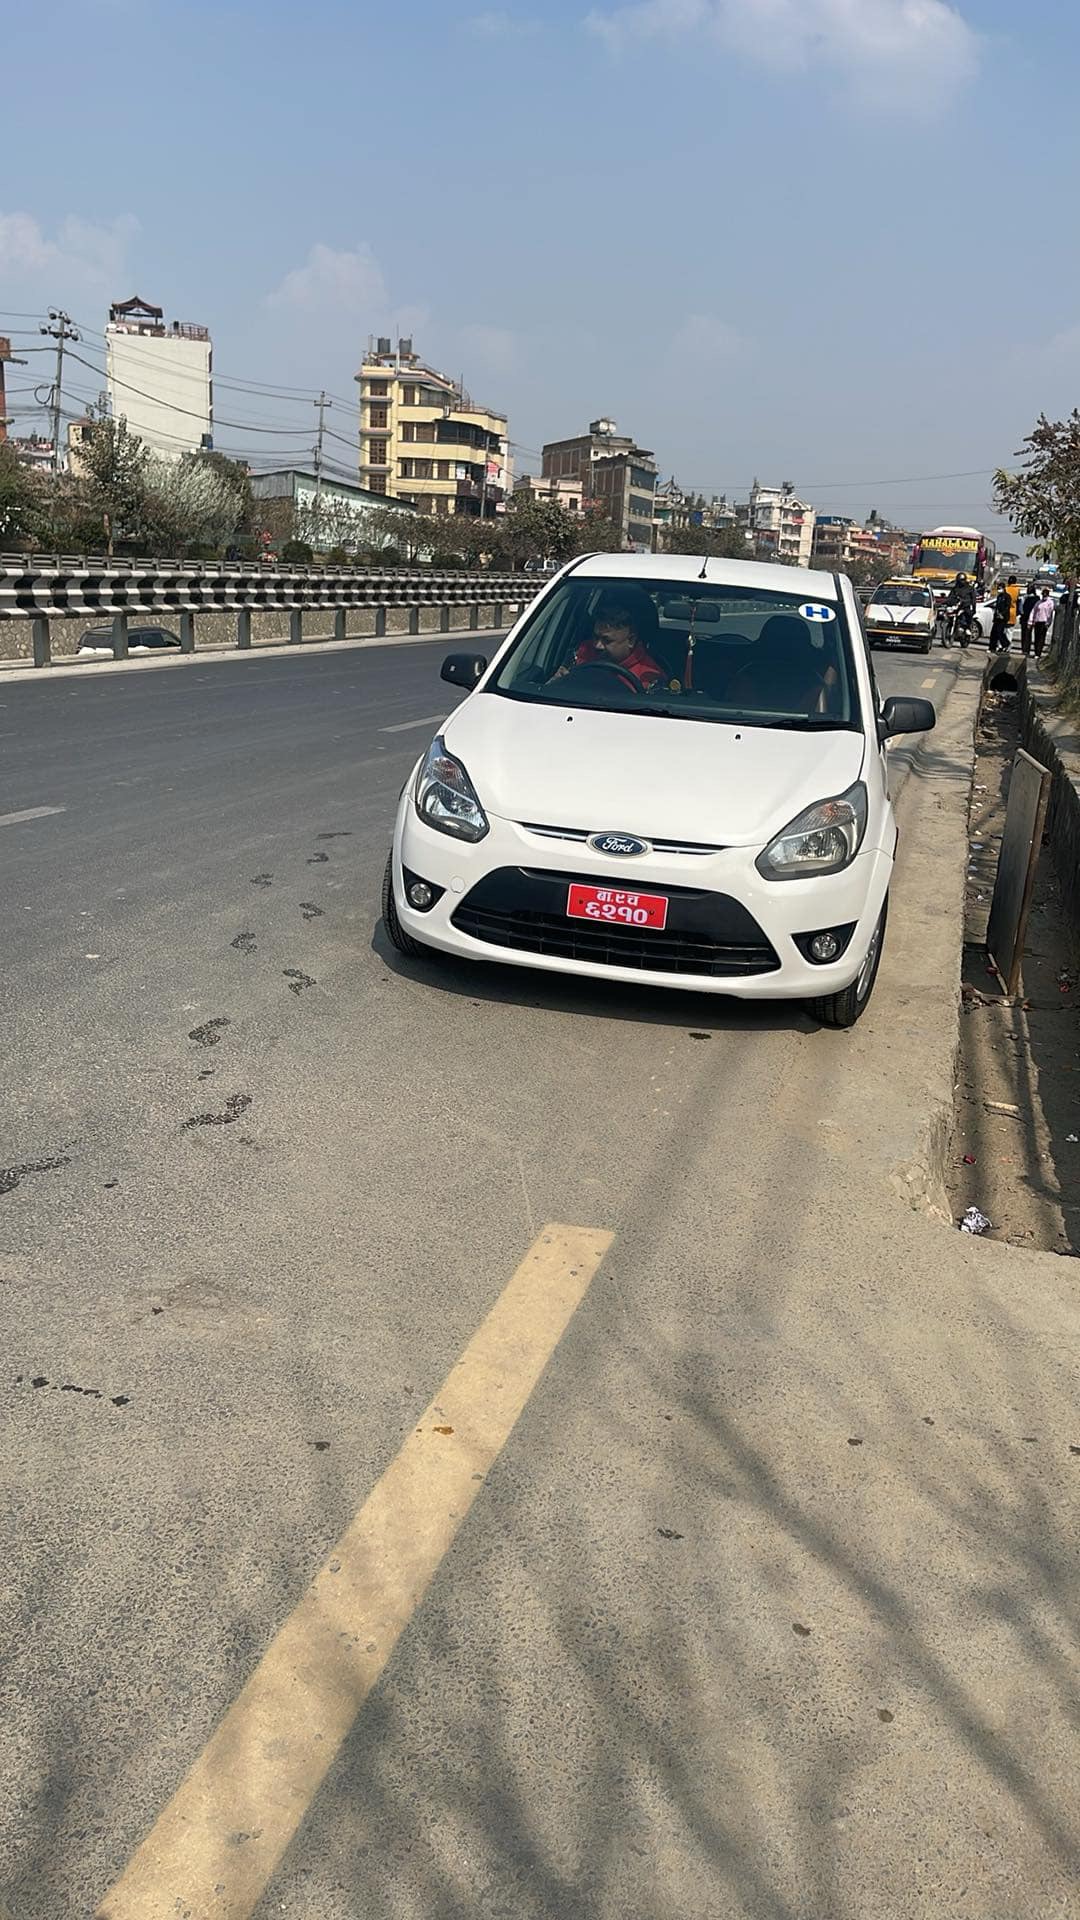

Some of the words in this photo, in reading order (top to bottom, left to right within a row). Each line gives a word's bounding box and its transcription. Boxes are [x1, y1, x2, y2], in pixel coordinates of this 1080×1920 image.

[805, 606, 829, 619] H
[602, 837, 634, 852] Ford
[585, 901, 648, 924] ६२१०
